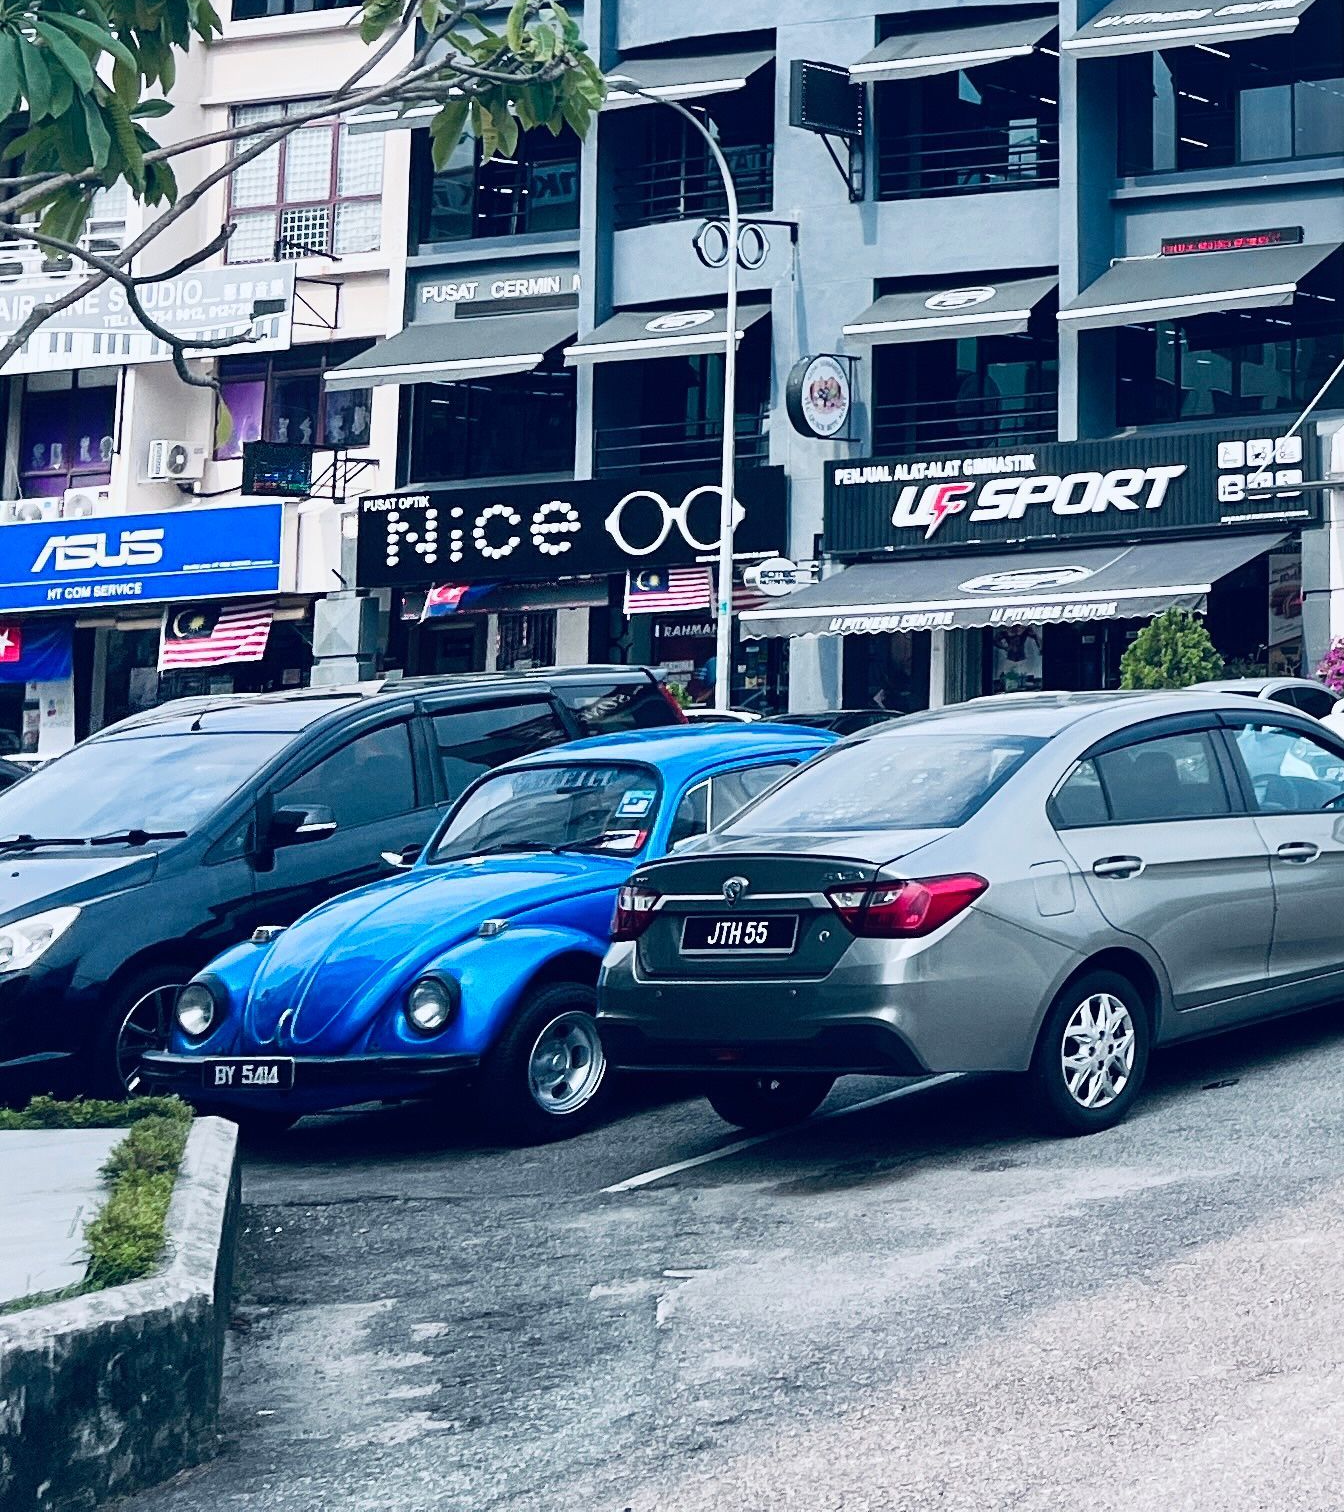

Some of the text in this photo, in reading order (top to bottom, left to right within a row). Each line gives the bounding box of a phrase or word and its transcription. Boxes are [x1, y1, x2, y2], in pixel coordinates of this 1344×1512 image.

[107, 279, 203, 313] SUDIO
[422, 282, 478, 303] PUSAT
[490, 276, 561, 299] CERMIN
[834, 465, 892, 485] PENJUAL
[893, 459, 962, 480] ALAT-ALAT
[364, 496, 430, 512] PUSAT OPTIK
[969, 464, 1188, 522] SPORT
[386, 500, 582, 567] Nice
[31, 528, 165, 572] ASUS
[65, 586, 91, 599] COM
[94, 582, 143, 598] SERVICE
[707, 921, 768, 945] JTH 55
[214, 1065, 236, 1085] BY
